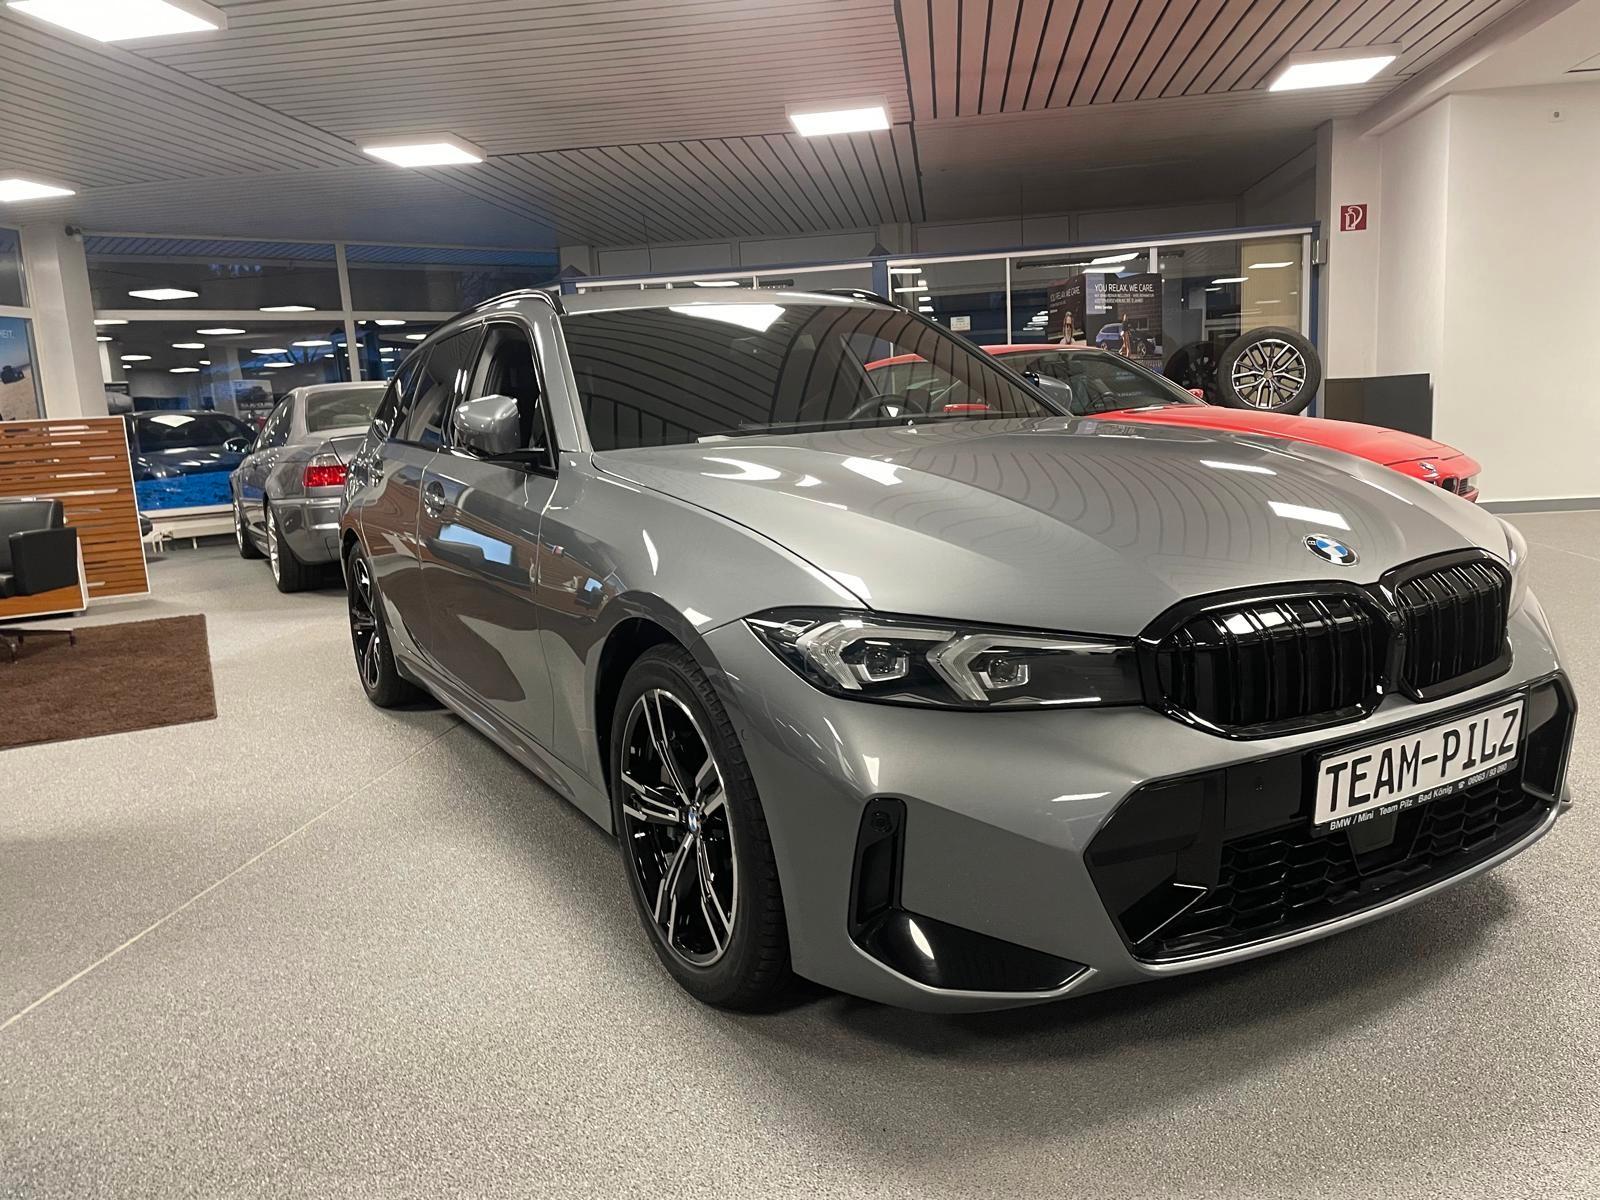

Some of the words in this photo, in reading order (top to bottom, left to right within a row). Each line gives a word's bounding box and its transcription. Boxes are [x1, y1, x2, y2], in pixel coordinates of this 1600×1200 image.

[1094, 283, 1107, 292] YOU
[1129, 283, 1138, 292] WE
[1325, 708, 1519, 813] TEAM-PILZ
[1330, 817, 1352, 831] BMW
[1358, 810, 1374, 824] Mini
[1380, 804, 1398, 816] Team
[1400, 799, 1413, 809] Pilz
[1418, 790, 1432, 803] Bad
[1433, 784, 1453, 798] König
